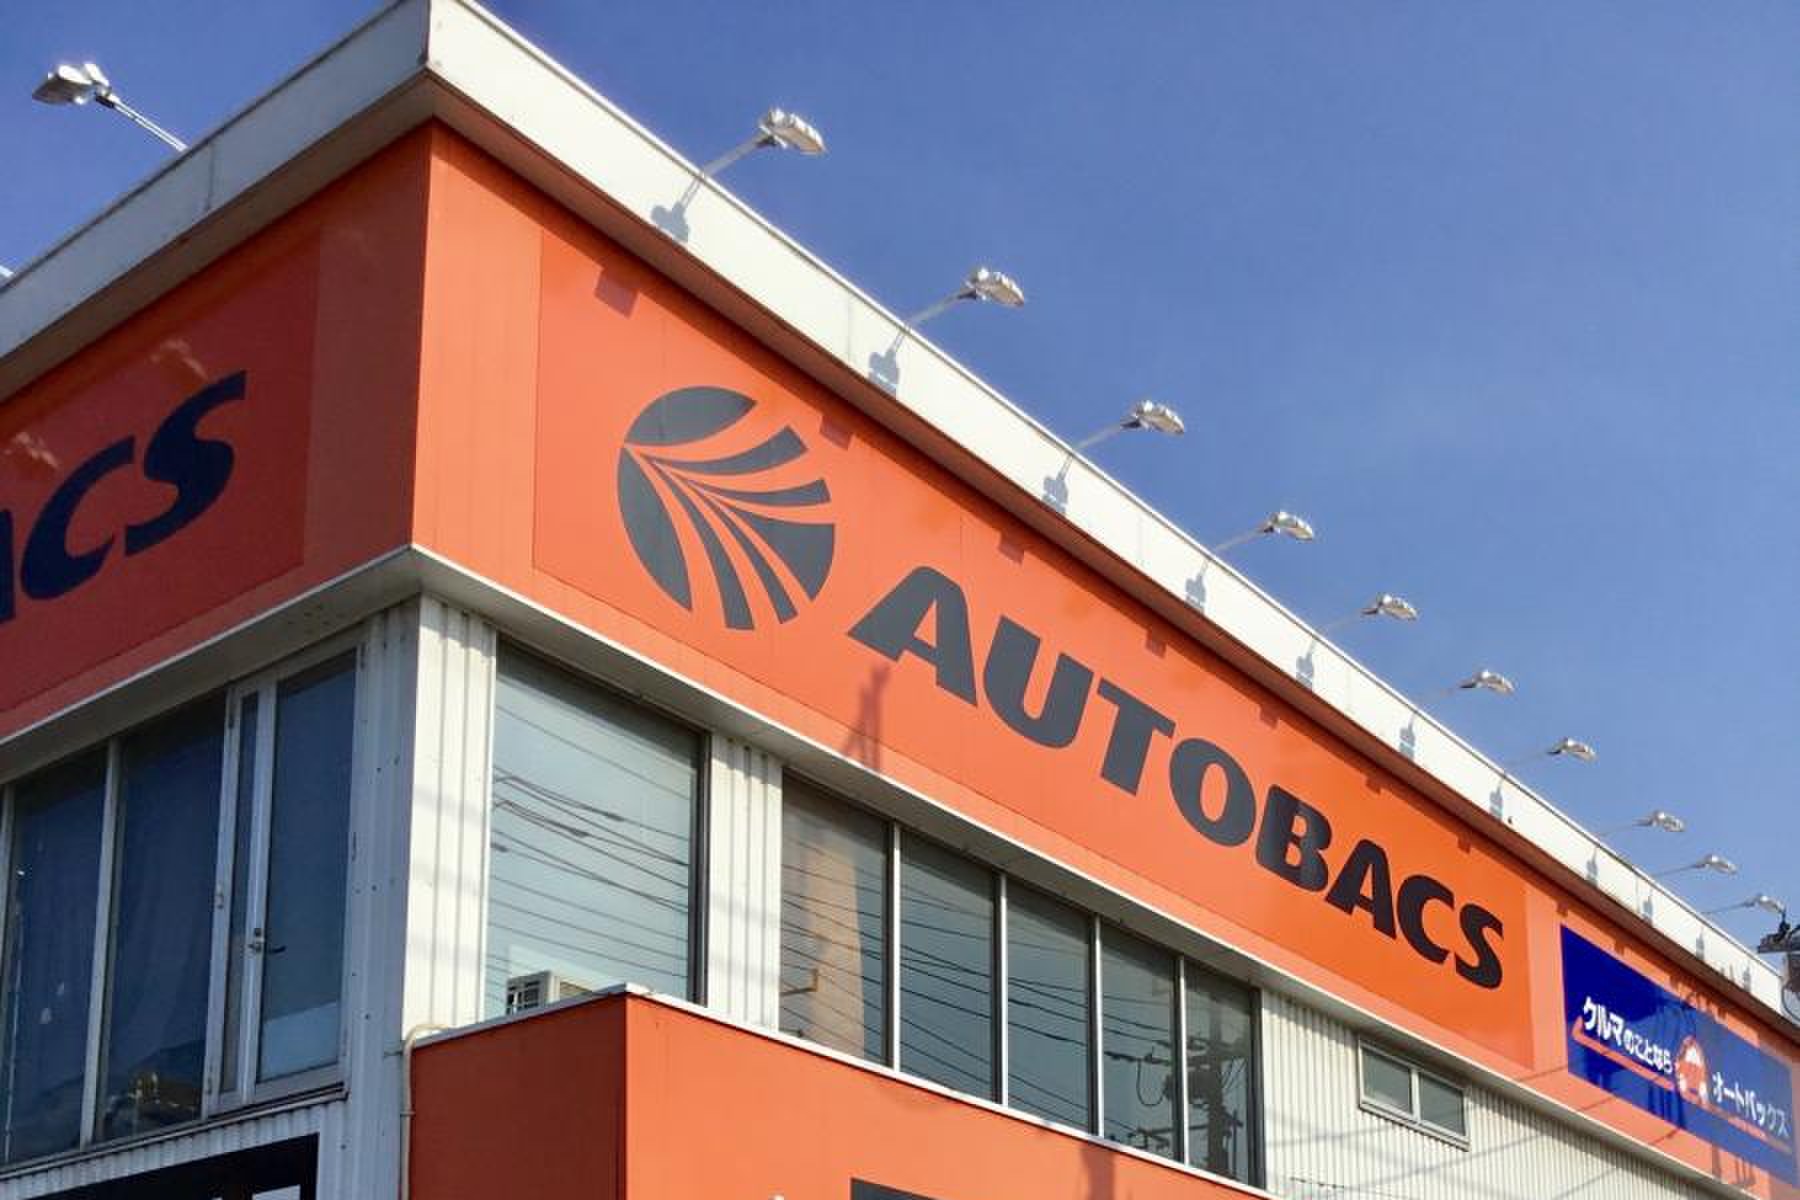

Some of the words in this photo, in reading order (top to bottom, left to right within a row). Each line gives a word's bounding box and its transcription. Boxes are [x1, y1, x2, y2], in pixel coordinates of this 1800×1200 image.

[0, 370, 247, 624] CS
[848, 566, 1504, 989] AUTOBACS
[1711, 1072, 1789, 1137] オートバックス
